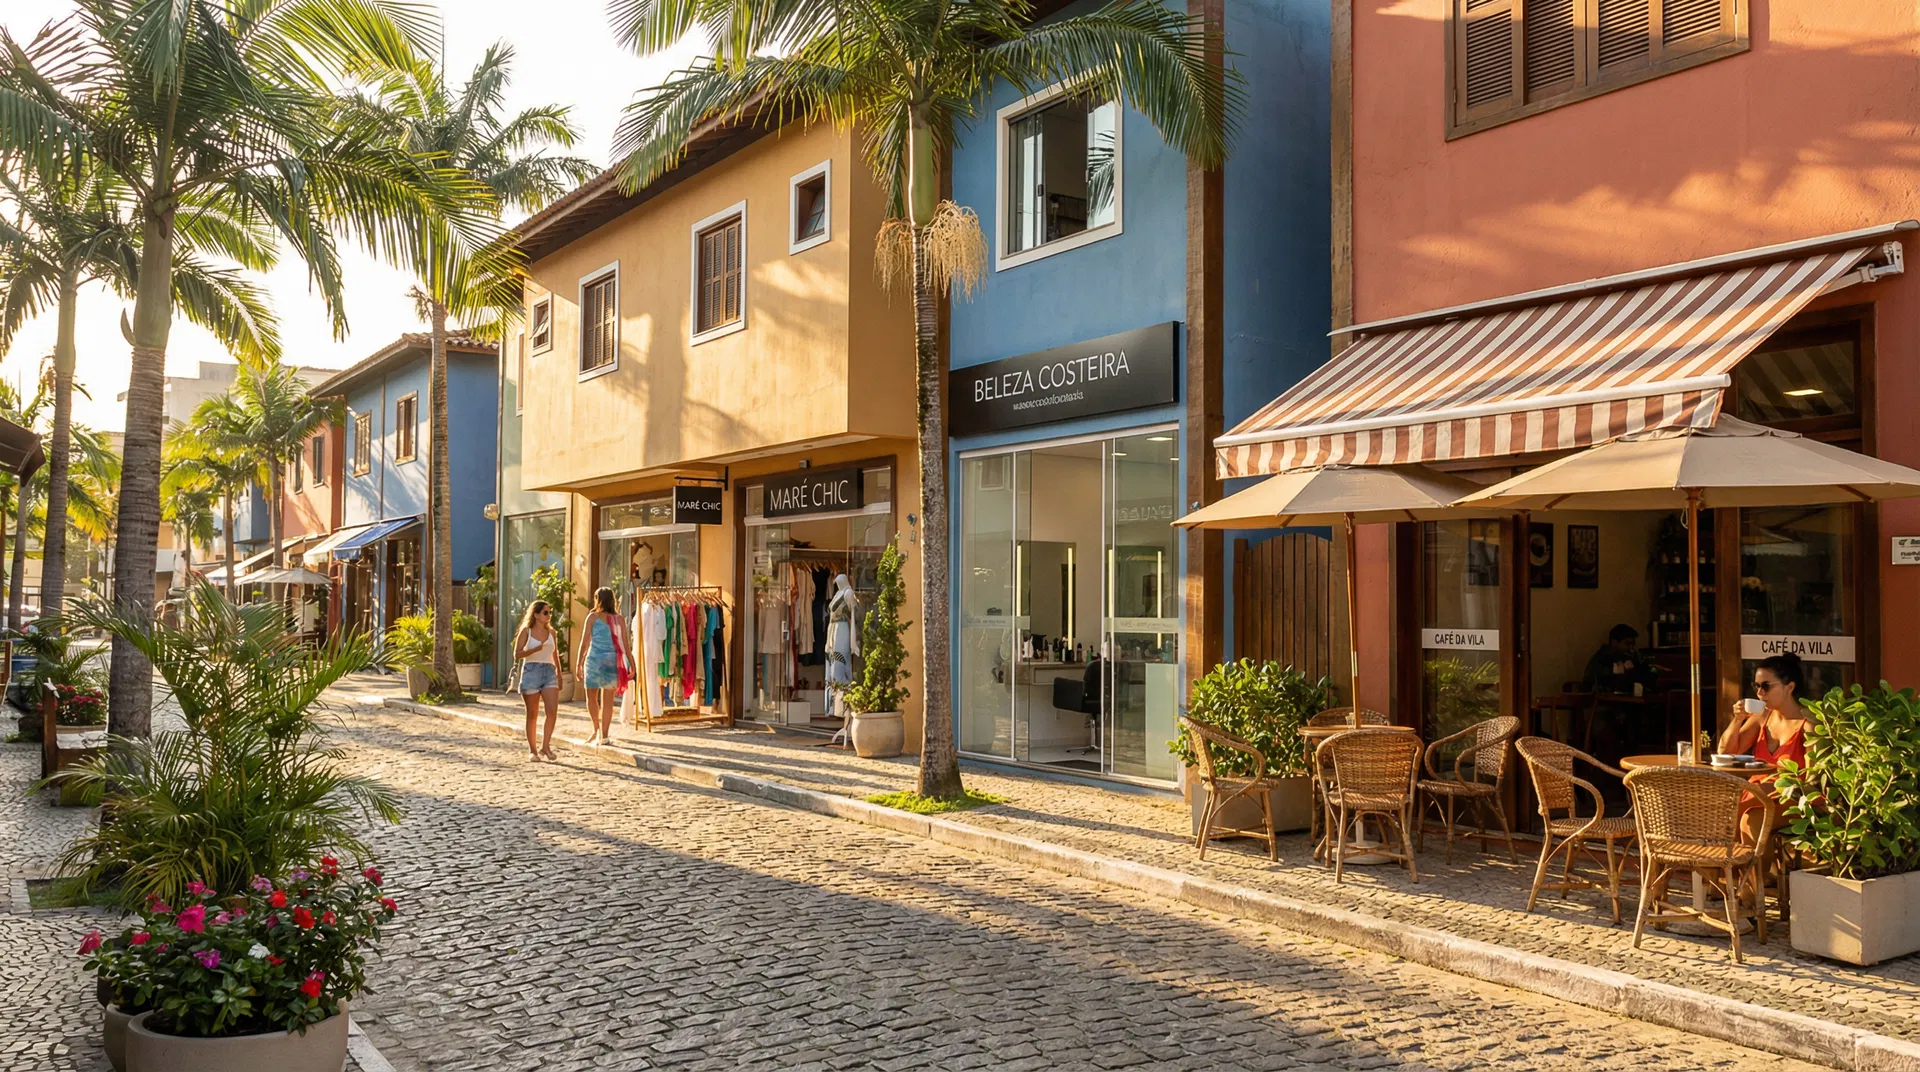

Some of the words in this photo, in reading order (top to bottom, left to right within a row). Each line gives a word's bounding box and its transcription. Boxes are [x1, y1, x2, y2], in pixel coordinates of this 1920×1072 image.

[974, 369, 1034, 402] BELEZA
[1038, 349, 1130, 390] COSTEIRA
[677, 495, 700, 510] MARÉ
[701, 501, 721, 511] CHIC
[769, 478, 808, 511] MARÉ
[811, 480, 849, 507] CHIC
[1434, 631, 1453, 645] CAFÉ
[1455, 634, 1466, 645] DA
[1467, 634, 1485, 646] VILA
[1761, 637, 1788, 653] CAFÉ
[1791, 640, 1806, 655] DA
[1808, 641, 1833, 655] VILA
